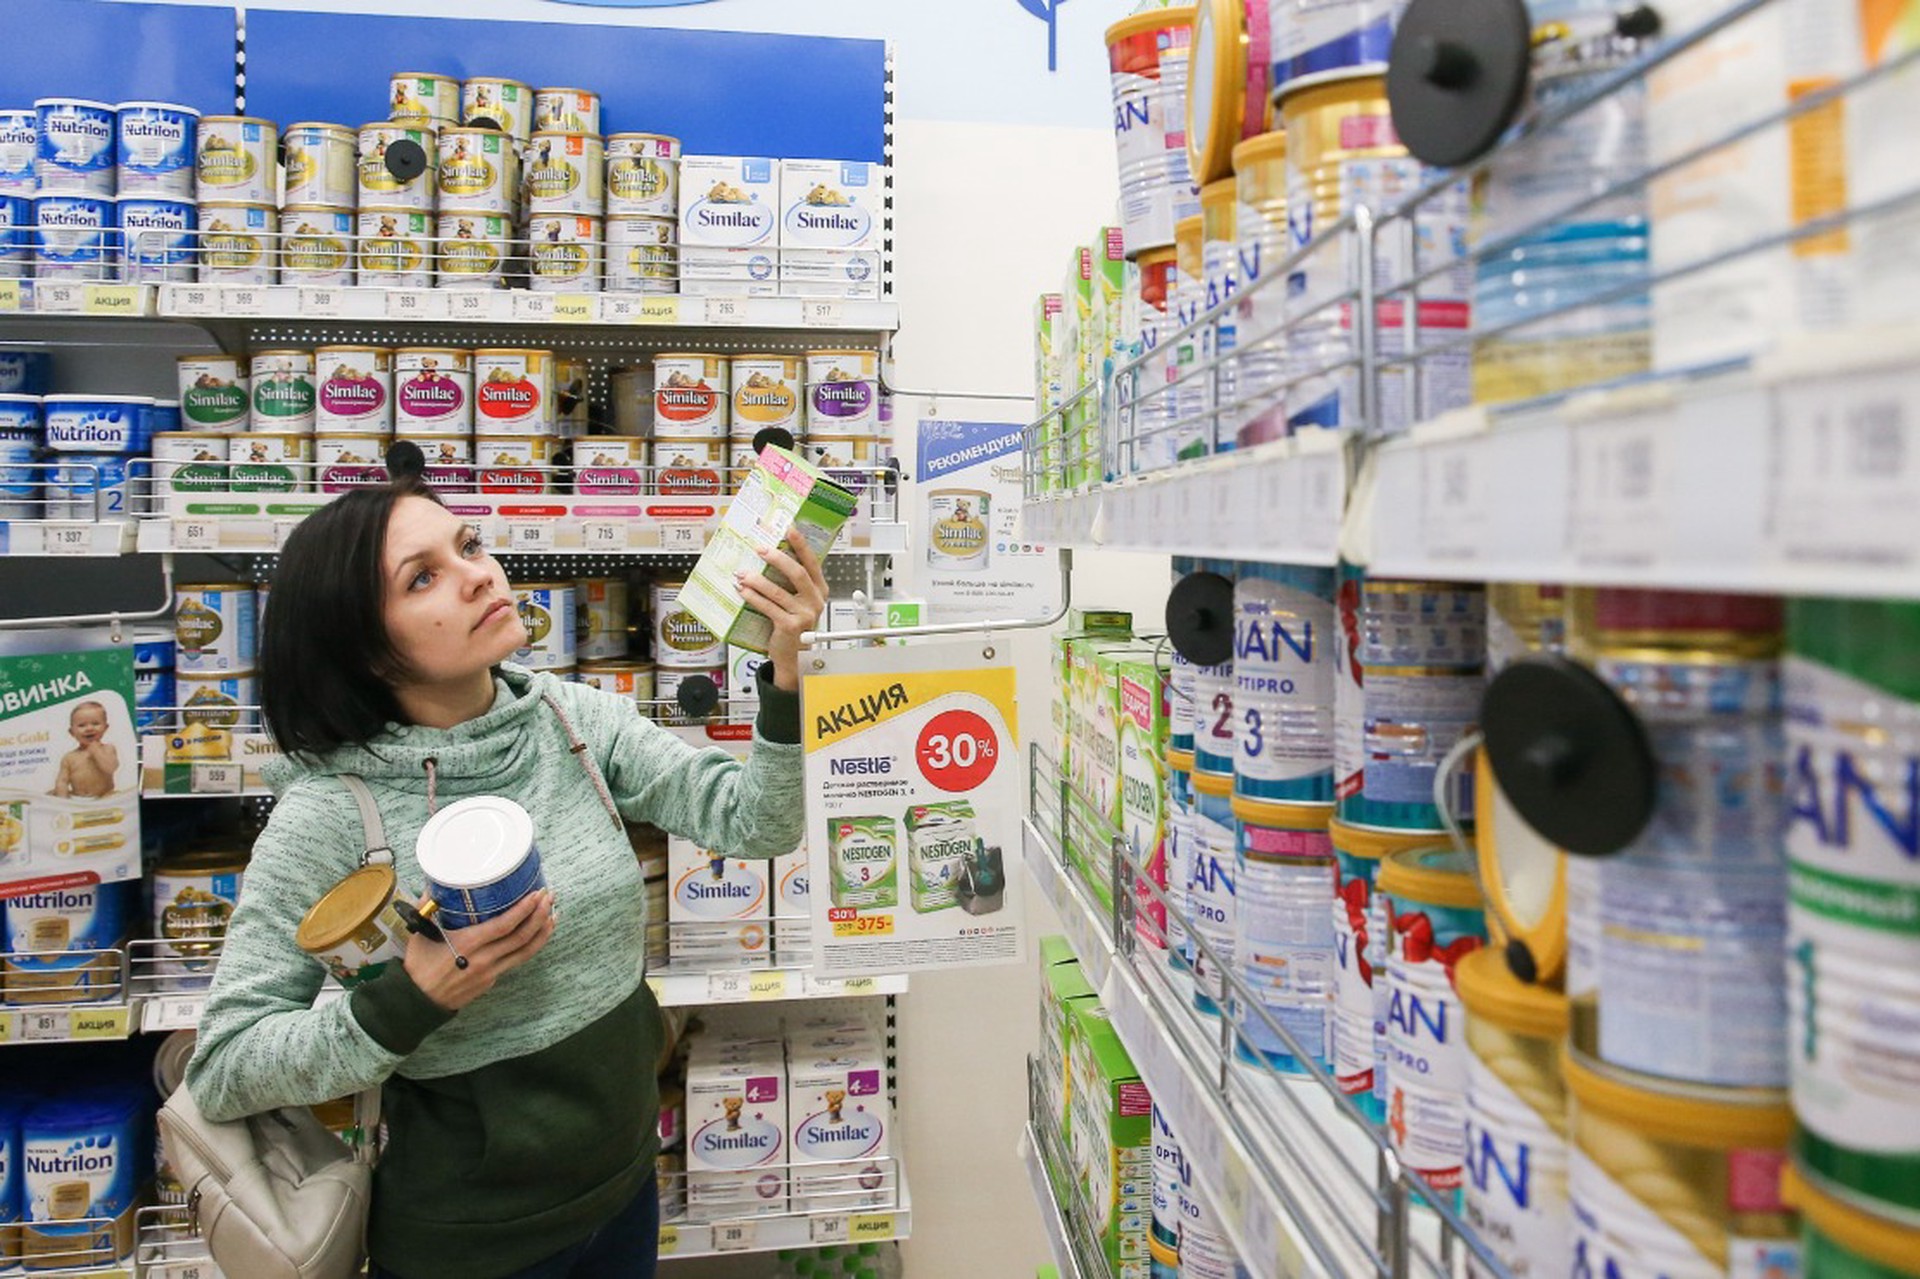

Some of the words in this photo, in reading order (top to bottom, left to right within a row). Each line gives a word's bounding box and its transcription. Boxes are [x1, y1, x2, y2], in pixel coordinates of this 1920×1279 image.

[1115, 96, 1149, 134] AN
[51, 120, 110, 138] Nutrilon
[124, 121, 181, 139] Nutrilon
[0, 131, 35, 145] utrilo
[200, 153, 247, 169] Similac
[441, 163, 488, 180] Similac
[530, 169, 570, 184] Similac
[613, 168, 660, 185] Similac
[744, 164, 751, 182] 1
[843, 166, 850, 184] 1
[41, 212, 97, 227] Nutrilon
[126, 214, 183, 230] Nutrilon
[698, 209, 761, 229] Similac
[796, 211, 859, 231] Similac
[362, 239, 414, 253] Similac
[440, 243, 491, 256] Similac
[533, 246, 581, 261] Similac
[93, 296, 132, 307] АКЦИЯ
[553, 305, 588, 315] АКЦИЯ
[815, 304, 832, 317] 517
[189, 391, 241, 407] Similac
[258, 385, 310, 402] Similac
[325, 383, 378, 400] Similac
[403, 384, 455, 401] Similac
[481, 386, 532, 402] Similac
[661, 390, 709, 406] Similac
[740, 391, 789, 407] Similac
[818, 384, 867, 401] Similac
[50, 424, 123, 444] Nutrilon
[926, 430, 1025, 472] РЕКОМЕНДУЕМ
[182, 469, 224, 485] Simil
[234, 469, 286, 485] Similac
[486, 472, 537, 485] Similac
[584, 473, 634, 486] Similac
[664, 474, 713, 487] Similac
[106, 490, 124, 512] 2
[187, 526, 205, 539] 651
[675, 528, 692, 541] 715
[937, 525, 983, 541] Similac
[532, 592, 542, 602] 3
[520, 614, 545, 628] ilac
[667, 618, 710, 634] Simila
[890, 611, 900, 626] 2
[0, 670, 93, 715] ВИНКА
[615, 678, 625, 691] 3
[1238, 676, 1295, 694] PTIPRO
[816, 683, 909, 740] АКЦИЯ
[1211, 693, 1234, 739] 2
[1243, 708, 1264, 758] 3
[921, 733, 994, 770] -30%
[858, 789, 899, 799] NESTOGEN
[842, 844, 892, 862] NESTOGEN
[919, 839, 972, 861] NESTOGEN
[860, 866, 871, 882] 3
[939, 864, 951, 881] 4
[686, 880, 752, 900] Similac
[9, 891, 93, 909] Nutrilon
[165, 910, 231, 930] Similac
[829, 908, 857, 921] -30%
[856, 916, 893, 931] 375-
[845, 977, 874, 989] КЦИЯ
[38, 1018, 55, 1030] 851
[1389, 987, 1447, 1045] AN
[77, 1019, 116, 1031] АКЦИЯ
[747, 1086, 760, 1101] 4
[849, 1079, 862, 1094] 4
[703, 1133, 769, 1152] Similac
[806, 1125, 871, 1145] Similac
[26, 1152, 114, 1174] Nutrilon
[856, 1220, 890, 1232] АКЦИЯ
